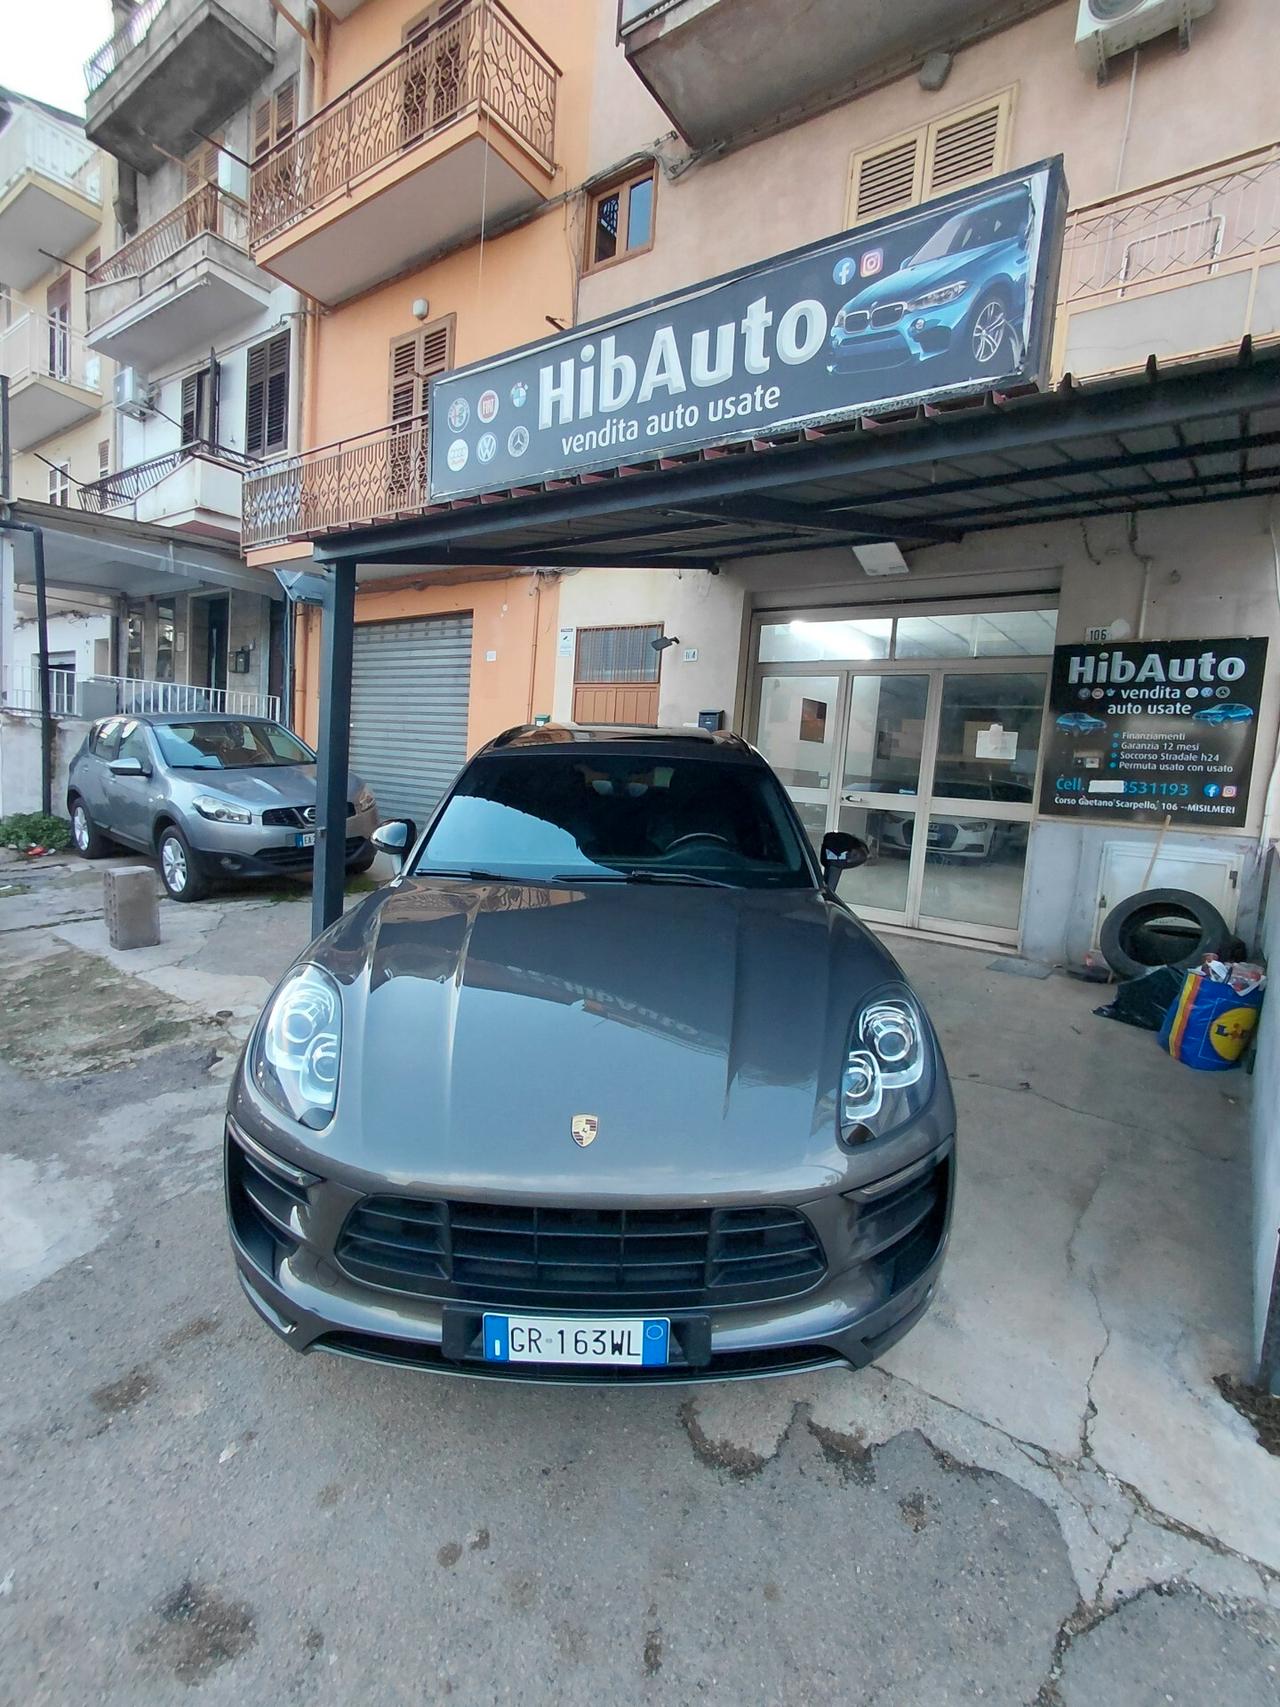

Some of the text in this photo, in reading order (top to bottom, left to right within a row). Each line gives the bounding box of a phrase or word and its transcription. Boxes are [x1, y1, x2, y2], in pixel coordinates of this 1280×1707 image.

[538, 296, 828, 430] HibAuto
[561, 384, 780, 456] vendita auto usate
[1090, 629, 1107, 641] 106
[1068, 651, 1245, 684] HibAuto
[1121, 685, 1180, 699] vendita
[1107, 702, 1191, 715] auto usate
[1122, 731, 1186, 741] Finanziamenti
[1121, 741, 1200, 751] Garanzia 12 mesi
[1120, 751, 1220, 762] Soccorso Stradale h24
[1119, 761, 1234, 773] Permuta usato con usato
[1054, 796, 1077, 805] Corso
[1078, 797, 1114, 807] Gaetano
[1161, 802, 1178, 811] 106
[1187, 803, 1236, 814] MISILMERI
[510, 1326, 543, 1354] GR
[557, 1329, 641, 1357] 163WL
